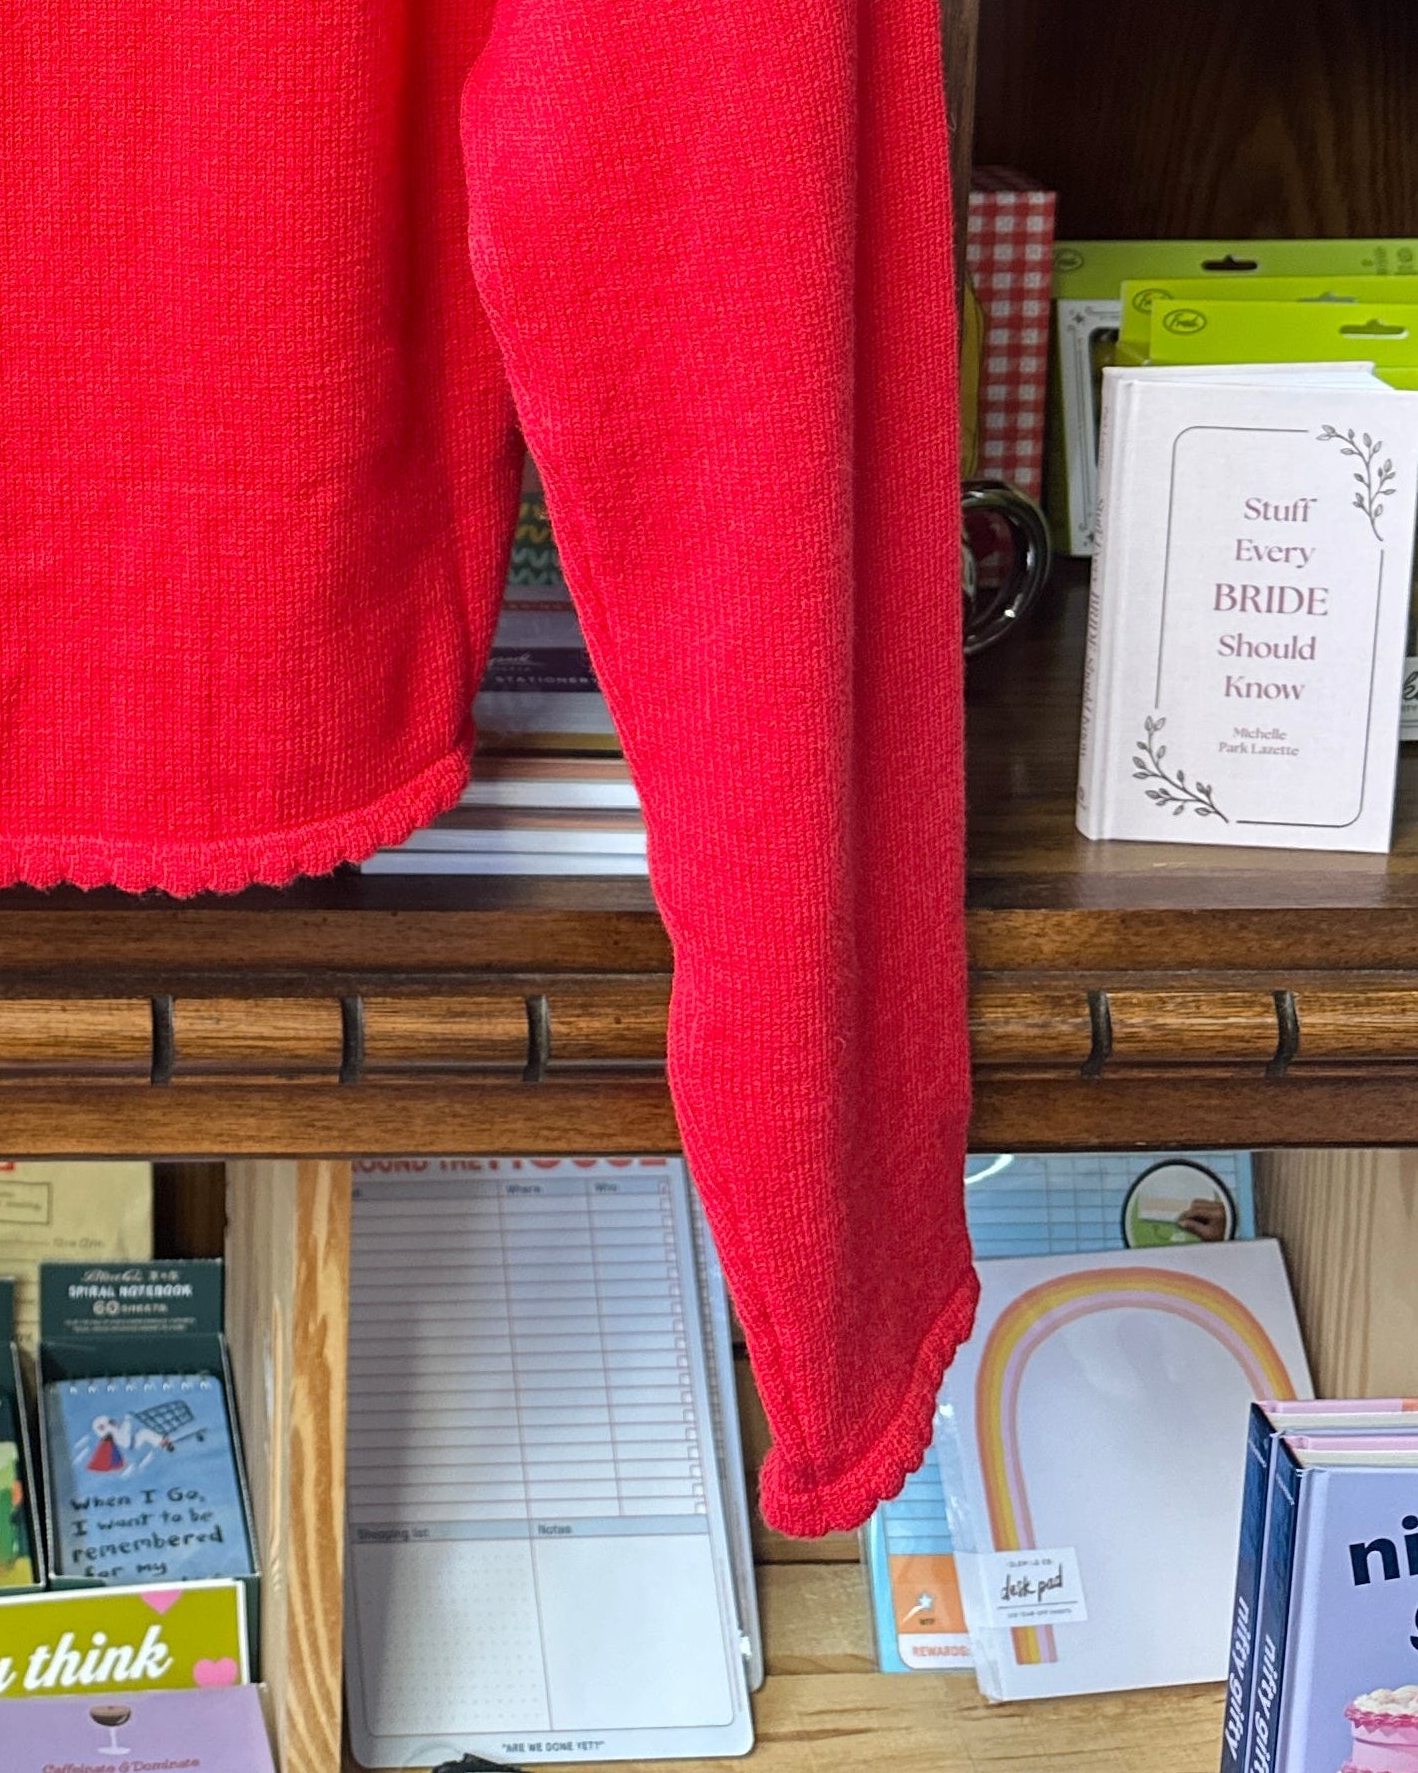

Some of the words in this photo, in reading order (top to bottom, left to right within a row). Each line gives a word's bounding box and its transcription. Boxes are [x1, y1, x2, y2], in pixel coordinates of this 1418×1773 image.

[1243, 497, 1318, 522] Stuff
[1235, 538, 1315, 569] Every
[1212, 583, 1329, 616] BRIDE
[1217, 633, 1317, 660] Should
[1223, 675, 1305, 700] Know
[1218, 741, 1248, 755] Park
[1250, 743, 1300, 756] Lazette
[1233, 727, 1287, 740] Michelle
[70, 1494, 131, 1510] When
[141, 1489, 156, 1504] I
[72, 1519, 87, 1536] I
[96, 1513, 154, 1530] want
[160, 1510, 182, 1523] to
[188, 1507, 213, 1522] be
[72, 1525, 224, 1563] remembered
[84, 1565, 124, 1578] for
[136, 1561, 168, 1575] my
[1001, 1574, 1036, 1601] desk
[1037, 1563, 1064, 1602] pad
[1231, 1595, 1250, 1681] nifty
[23, 1624, 175, 1692] think
[1257, 1633, 1278, 1724] nifty
[1224, 1671, 1245, 1761] gifty
[1249, 1711, 1272, 1773] gift
[132, 1758, 201, 1771] Dominate
